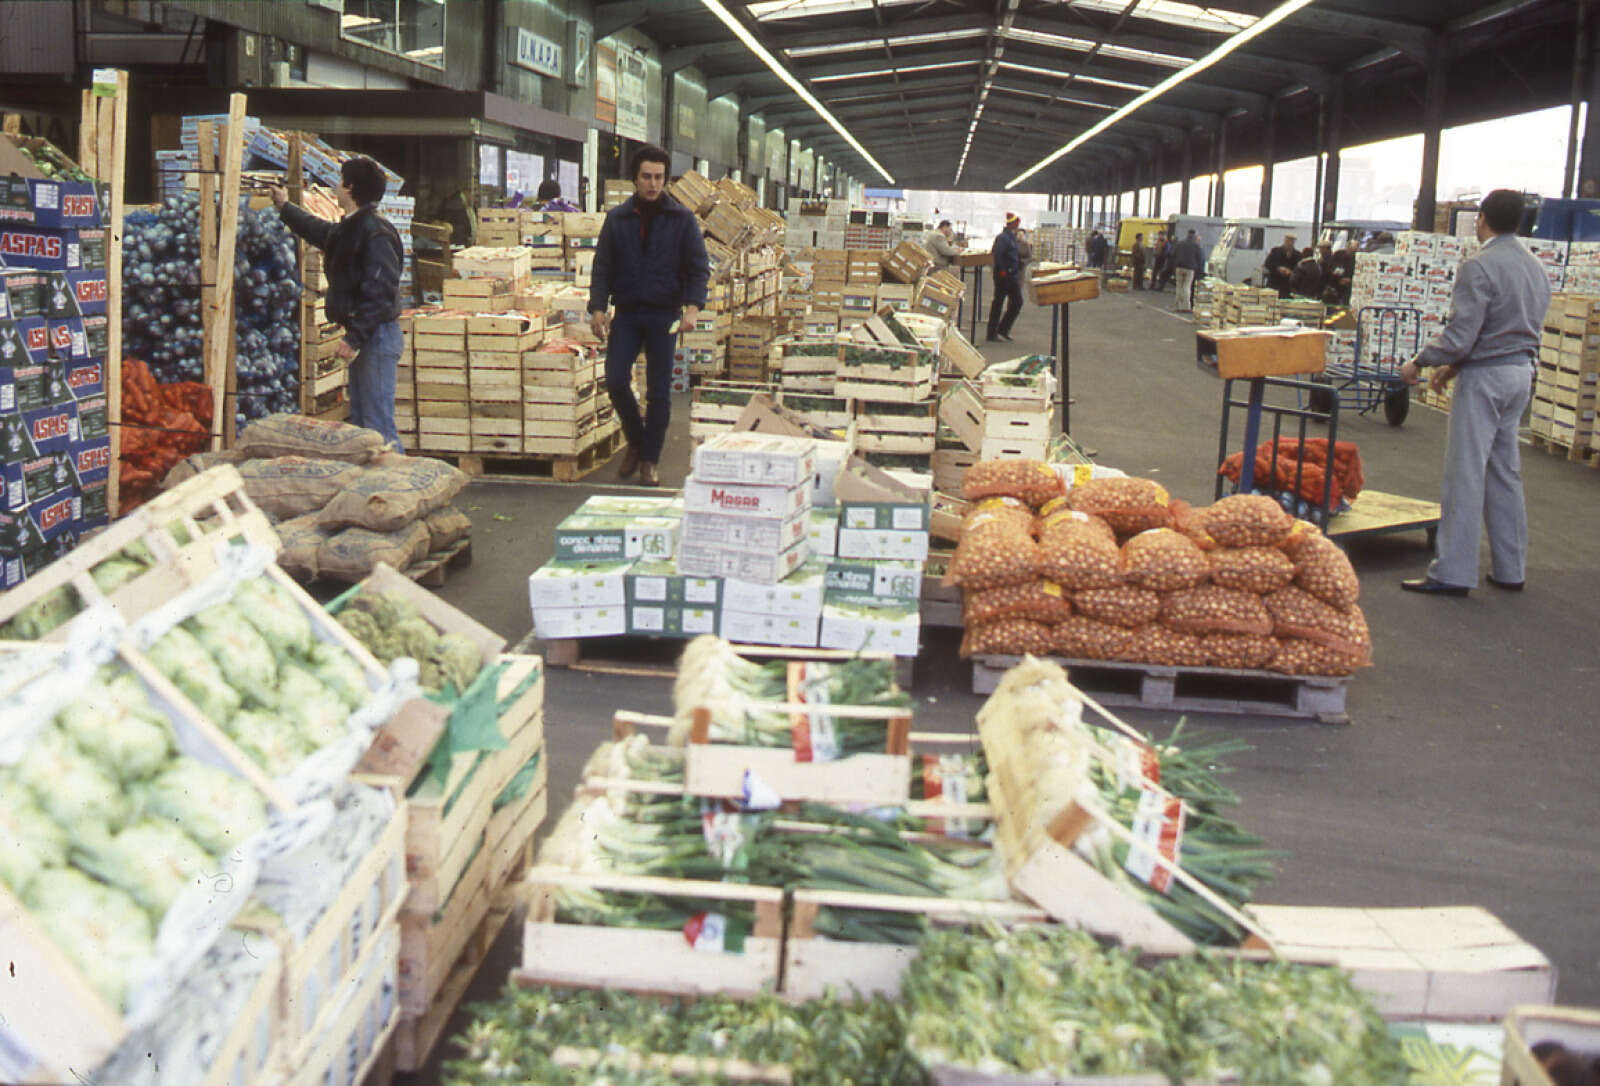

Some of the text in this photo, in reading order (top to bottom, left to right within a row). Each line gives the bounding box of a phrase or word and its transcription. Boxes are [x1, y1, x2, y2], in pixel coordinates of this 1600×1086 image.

[0, 232, 62, 259] ASPAS
[33, 413, 69, 442] ASPAS
[41, 497, 73, 532] ASPAS
